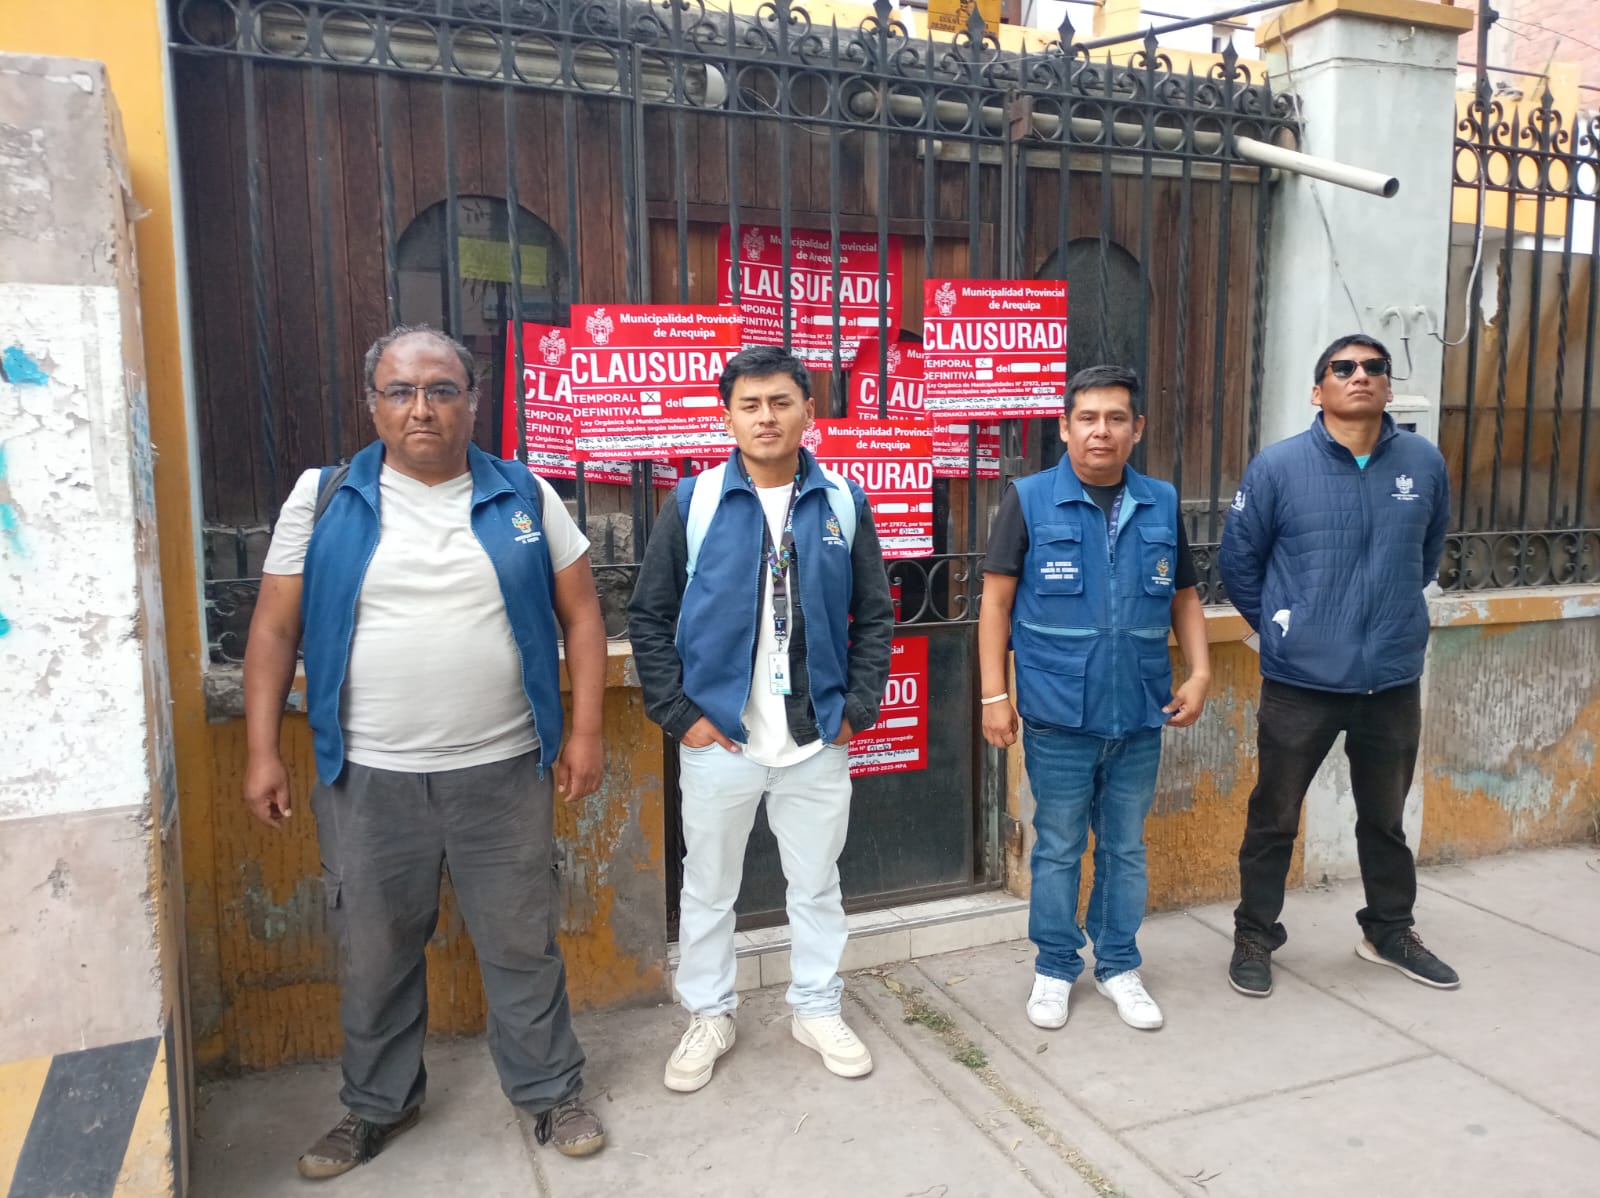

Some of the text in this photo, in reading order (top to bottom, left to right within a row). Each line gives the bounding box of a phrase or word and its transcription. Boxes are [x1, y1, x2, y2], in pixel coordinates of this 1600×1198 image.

[770, 234, 829, 250] Mucipalidad
[796, 251, 848, 265] de Arequpa
[962, 287, 1065, 299] Municipalidad Provincial
[740, 304, 777, 316] MPORAL
[989, 300, 1041, 312] de Arequipa
[619, 313, 741, 326] Municipalidad Provincia
[848, 318, 857, 326] al
[653, 328, 716, 340] de Arequipa
[923, 322, 1067, 350] CLAUSURAD
[571, 352, 738, 384] CLAUSURA
[996, 363, 1011, 373] del
[1041, 364, 1051, 372] al
[573, 393, 636, 404] TEMPORAL
[665, 398, 682, 407] del
[525, 408, 573, 423] EMPORA
[573, 407, 640, 417] DEFINITIVA
[525, 422, 573, 436] EFINITIV
[828, 426, 932, 438] Municipalidad Provincia
[933, 424, 948, 433] del
[856, 440, 911, 452] de Arequipa
[633, 449, 670, 457] MUNICIPAL
[608, 474, 632, 482] VIGENT
[909, 505, 919, 513] al
[877, 720, 886, 729] al
